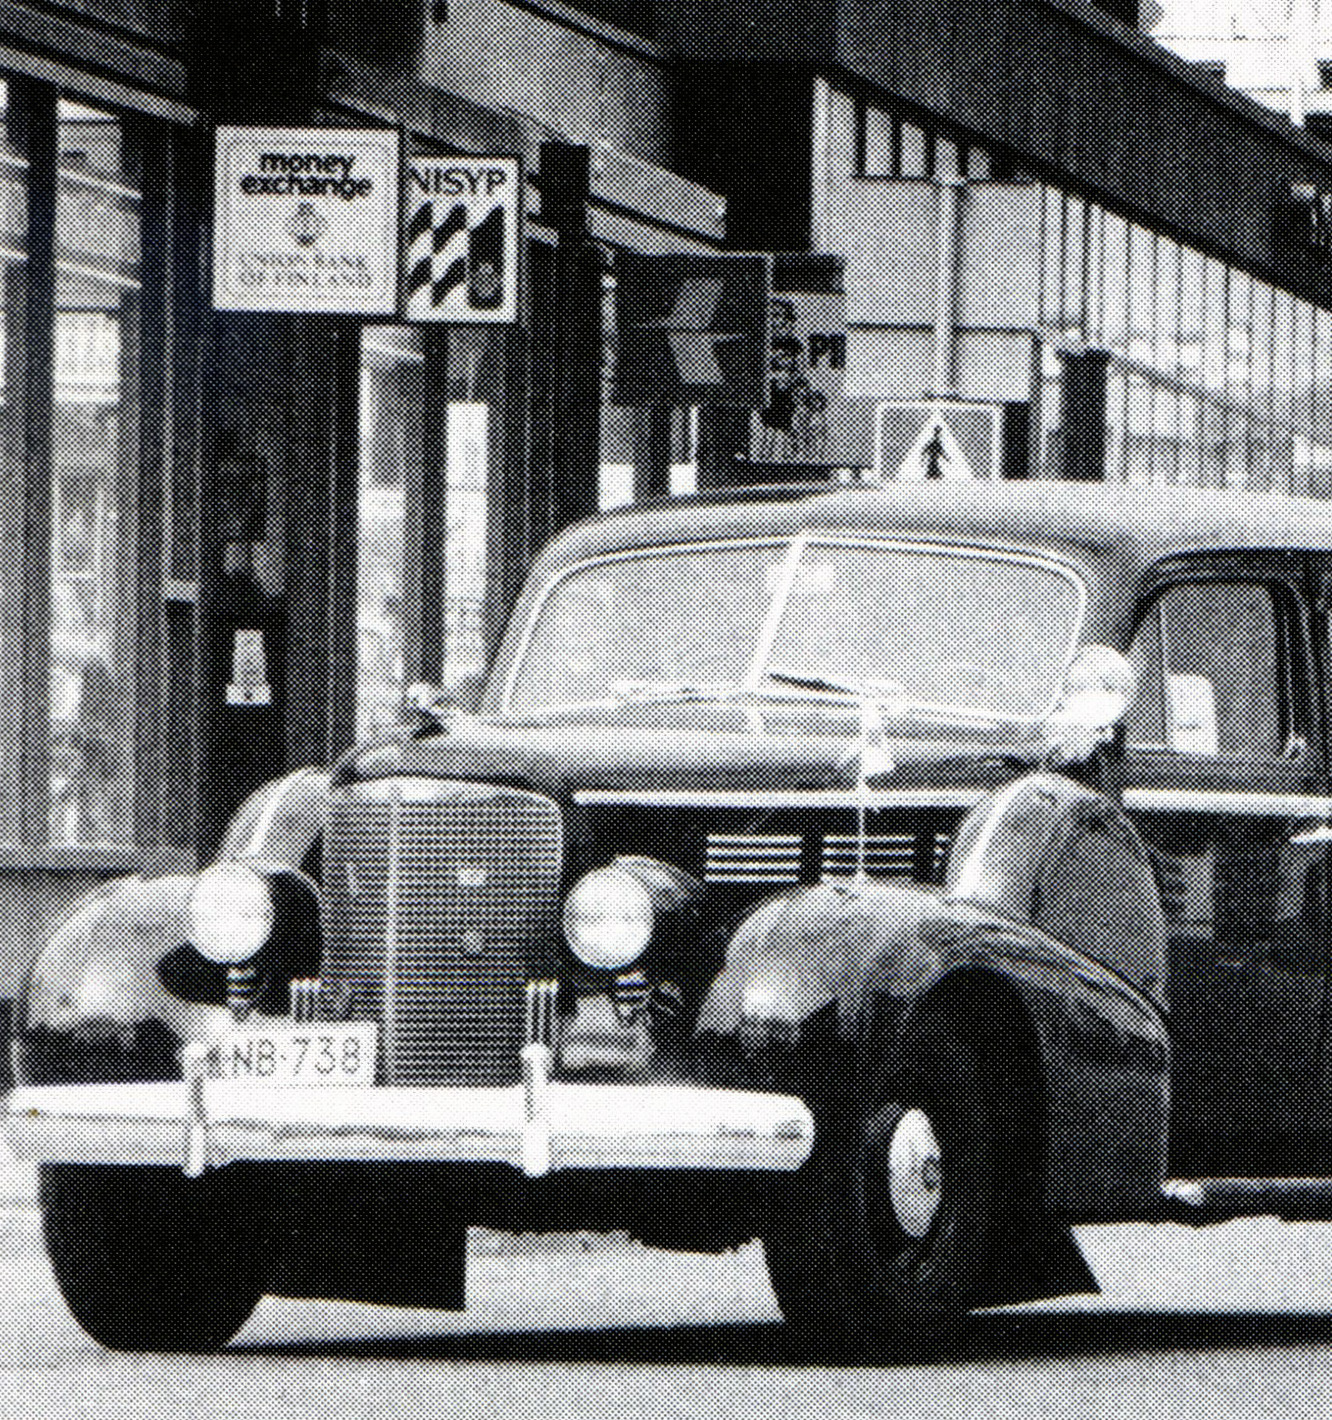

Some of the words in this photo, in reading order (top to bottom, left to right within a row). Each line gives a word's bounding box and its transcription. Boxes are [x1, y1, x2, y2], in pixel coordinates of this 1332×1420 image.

[260, 153, 356, 176] money
[240, 175, 373, 201] exchange
[240, 252, 307, 271] UNION
[313, 252, 369, 271] BANK
[240, 271, 264, 288] OF
[273, 271, 373, 289] FINLAND
